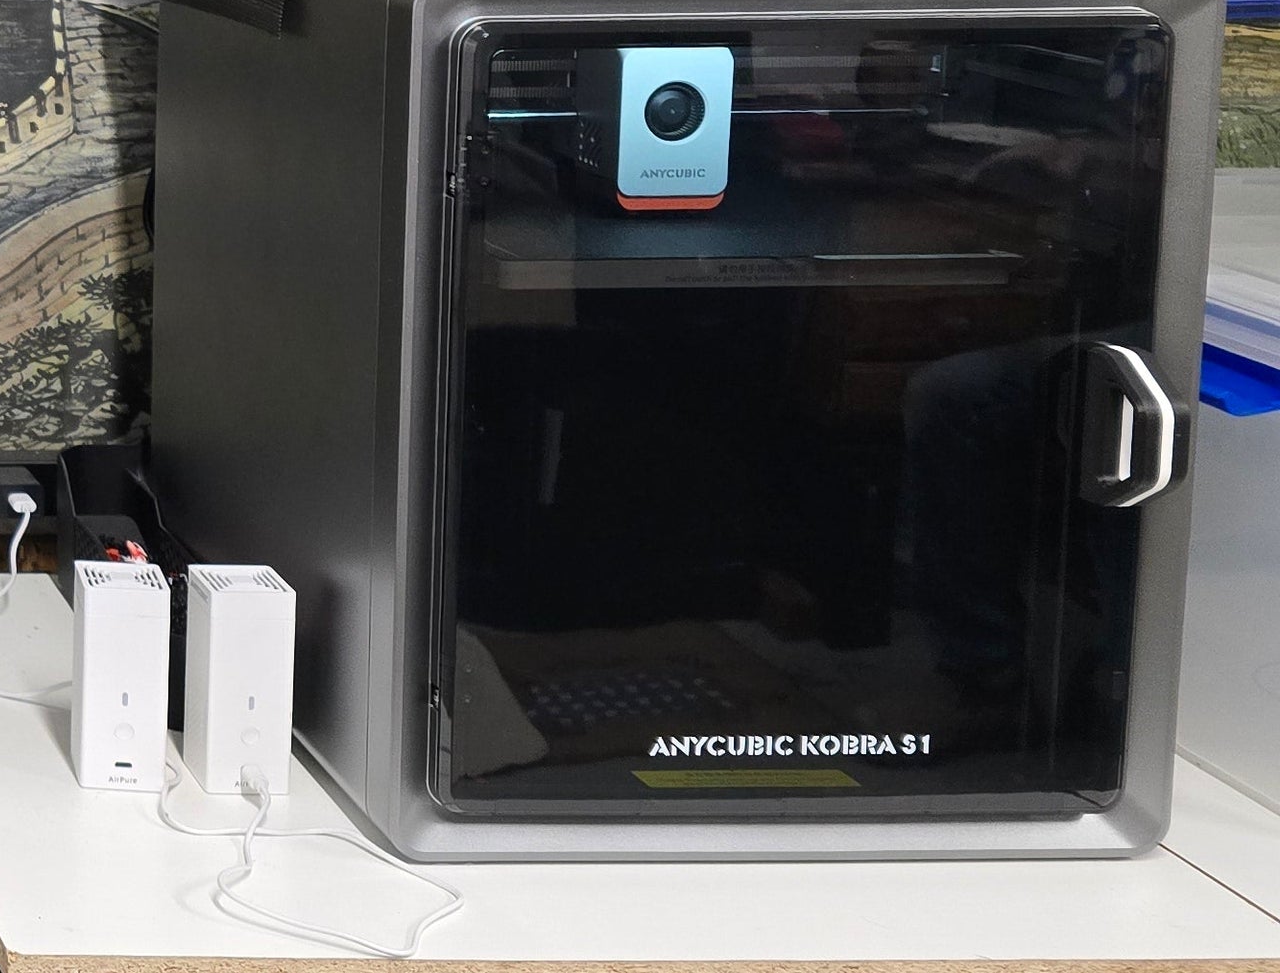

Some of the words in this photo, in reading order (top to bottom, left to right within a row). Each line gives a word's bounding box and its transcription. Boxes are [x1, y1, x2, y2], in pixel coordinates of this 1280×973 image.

[639, 168, 707, 179] ANYCUBIC
[648, 735, 795, 757] ANYCUBIC
[800, 734, 898, 756] KOBRA
[901, 733, 931, 754] S1
[108, 775, 138, 785] AirPure
